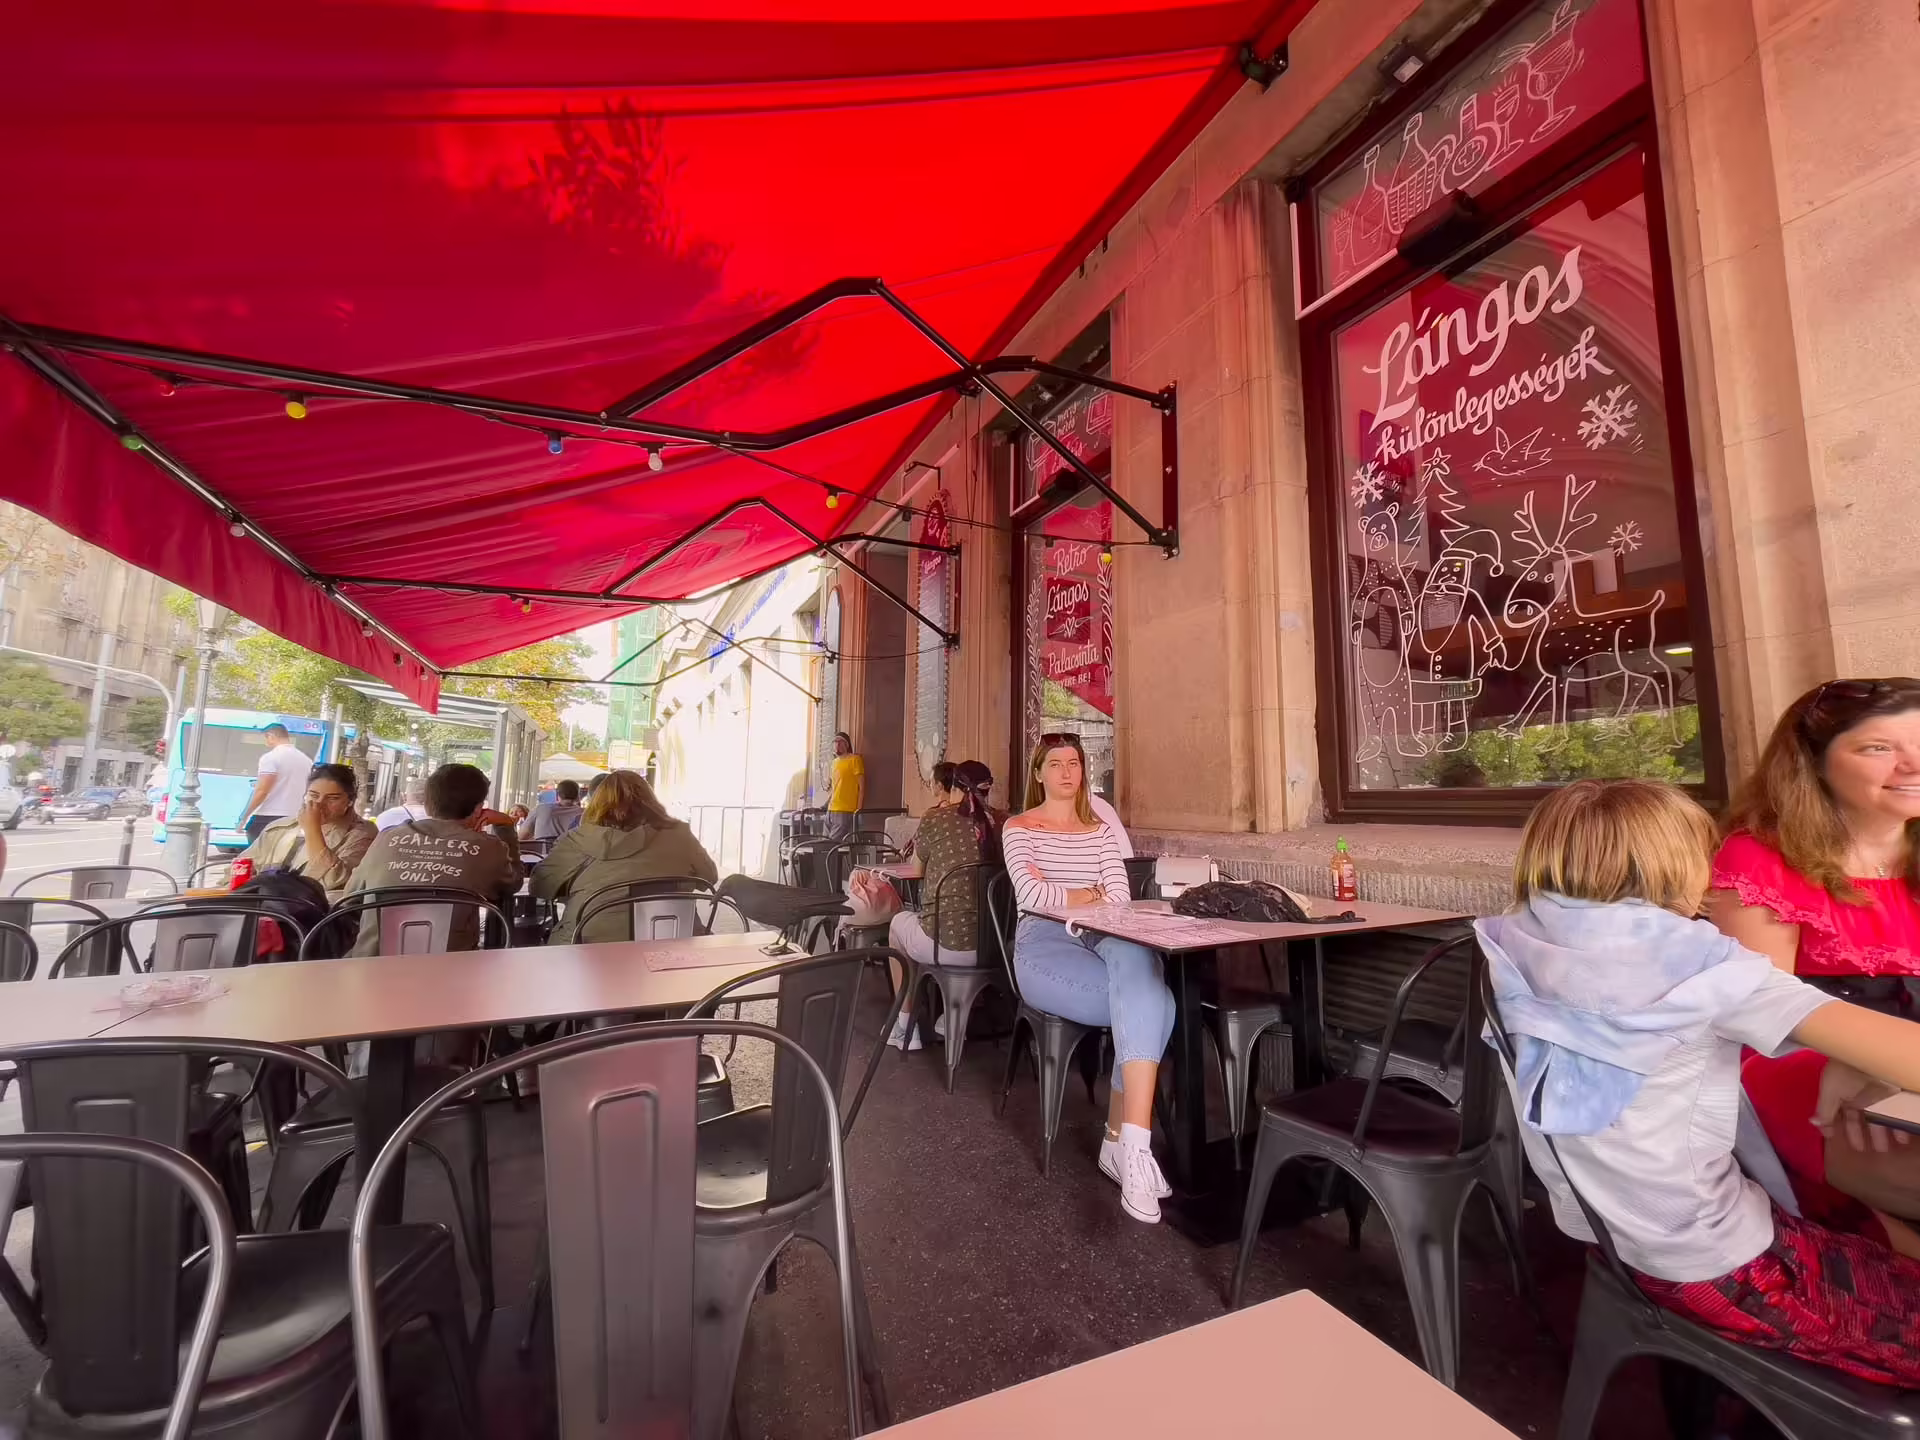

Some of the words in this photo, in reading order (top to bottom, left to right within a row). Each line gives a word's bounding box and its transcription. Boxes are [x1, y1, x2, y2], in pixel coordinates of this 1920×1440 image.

[1362, 245, 1583, 434] Lángos
[1375, 325, 1615, 465] különlegességek
[1053, 543, 1093, 580] Retro
[1043, 580, 1089, 622] Lángos
[1047, 639, 1099, 677] Palacsinta
[387, 861, 409, 871] TWO
[411, 861, 463, 877] STROKES
[399, 870, 440, 883] ONLY
